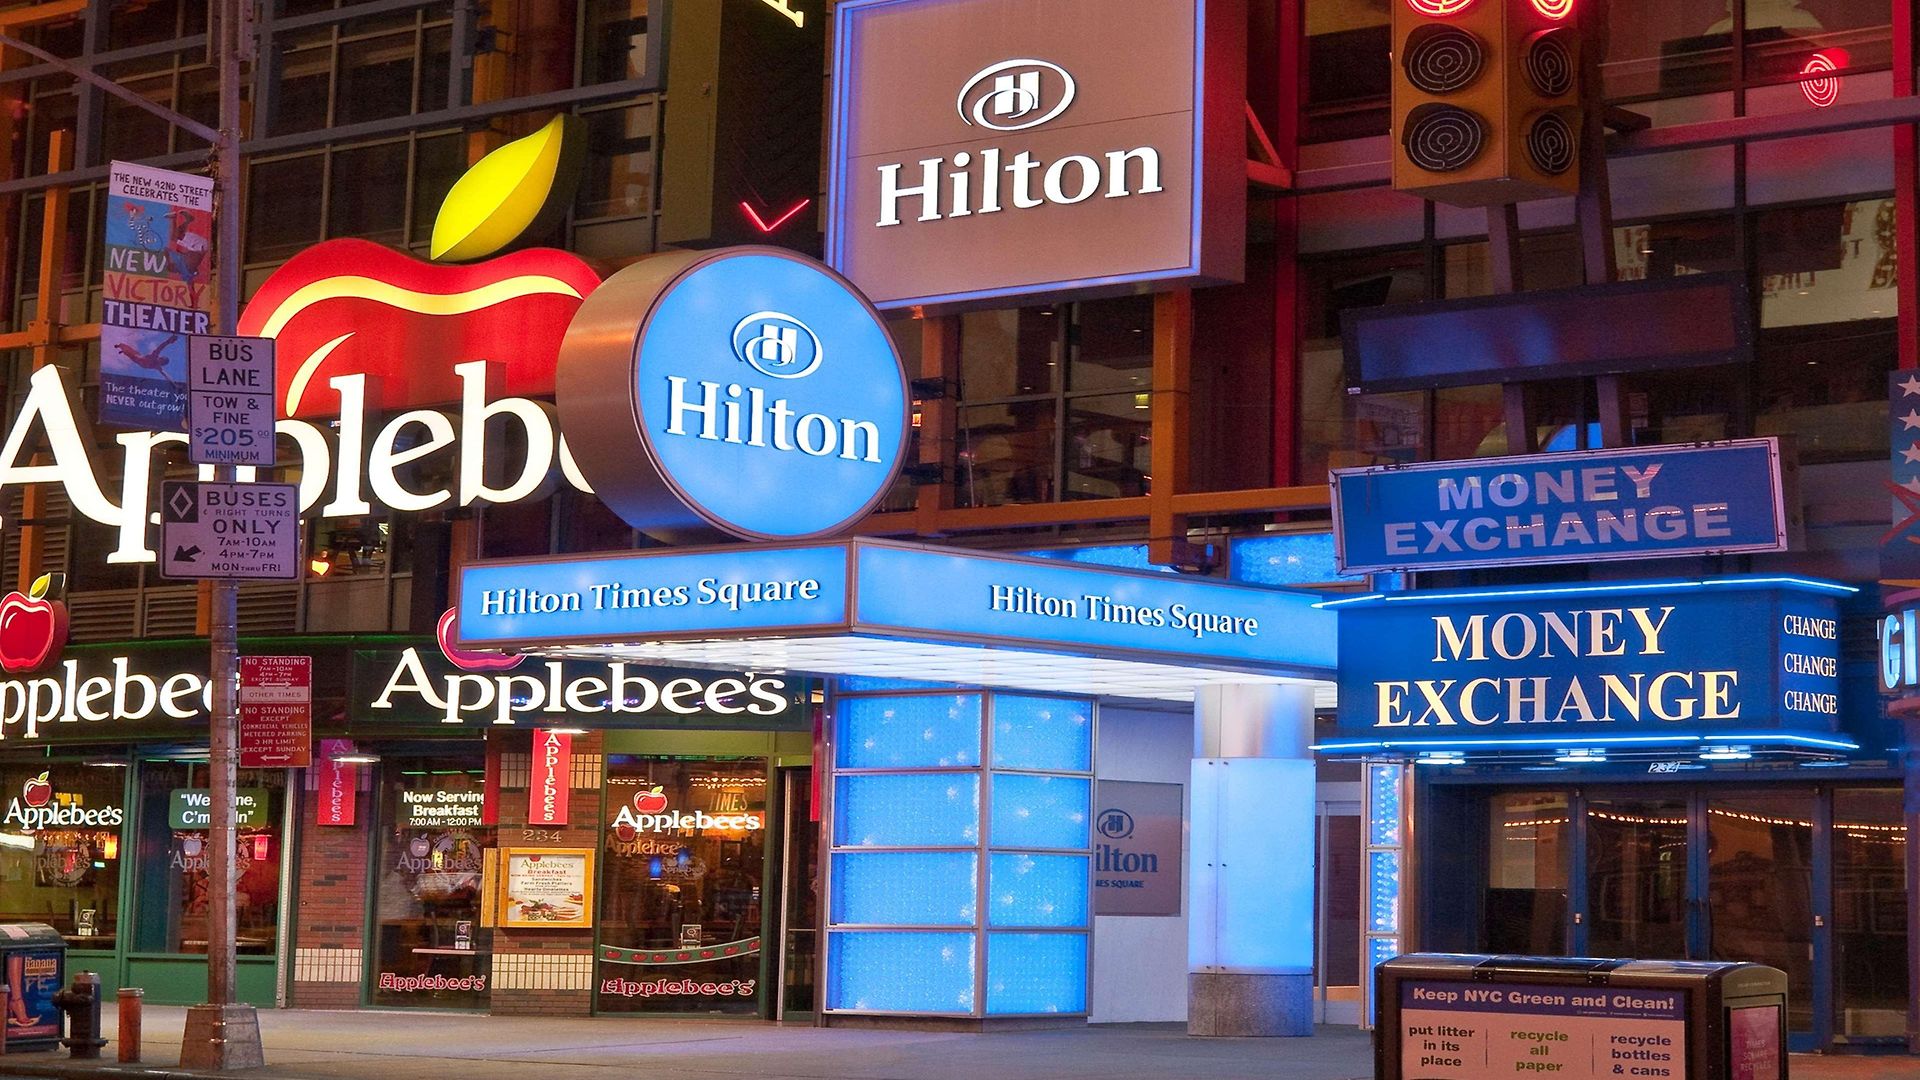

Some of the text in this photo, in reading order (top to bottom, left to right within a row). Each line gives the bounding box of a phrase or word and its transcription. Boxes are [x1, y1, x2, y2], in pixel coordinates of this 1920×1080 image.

[114, 173, 210, 197] THE NEW 42ND STREET
[875, 144, 1163, 228] Hilton
[123, 185, 199, 206] CELEBRATES THE
[110, 247, 166, 273] NEW
[109, 272, 206, 309] VICTORY
[105, 300, 208, 335] THEATER
[209, 343, 253, 362] BUS
[203, 367, 260, 387] LANE
[105, 382, 125, 392] The
[129, 383, 170, 398] theater
[106, 394, 185, 415] NEVER outgrow!
[203, 396, 259, 410] TOW &
[213, 412, 250, 425] FINE
[666, 375, 882, 464] Hilton
[205, 449, 259, 461] MINIMUM
[1438, 463, 1664, 512] MONEY
[206, 491, 286, 507] BUSES
[215, 509, 247, 517] RIGHT
[213, 519, 281, 534] ONLY
[1383, 502, 1732, 557] EXCHANGE
[481, 578, 820, 617] Hilton Times Square
[990, 584, 1259, 638] Hilton Times Square
[1431, 606, 1676, 663] MONEY
[1783, 614, 1837, 640] CHANGE
[1784, 653, 1837, 678] CHANGE
[370, 646, 788, 724] Applebee's
[1373, 670, 1740, 728] EXCHANGE
[1784, 690, 1838, 714] CHANGE
[1650, 762, 1679, 773] 234
[403, 791, 432, 803] Now
[3, 796, 123, 829] Applebee's
[412, 804, 479, 817] Breakfast
[611, 805, 761, 833] Applebee's
[409, 817, 426, 826] 7:00
[426, 817, 441, 826] AM
[447, 817, 467, 826] 12:00
[468, 817, 482, 826] PM
[522, 829, 562, 842] 234
[1111, 880, 1144, 888] SQUARE
[379, 972, 486, 991] Applebee's
[600, 978, 755, 998] Applebee's
[1413, 987, 1674, 1010] Keep NYC Green and Clean!
[1409, 1026, 1475, 1039] put litter
[1510, 1029, 1569, 1044] recycle
[1610, 1033, 1671, 1048] recycle
[1423, 1040, 1460, 1051] in its
[1530, 1045, 1549, 1056] all
[1420, 1054, 1462, 1068] place
[1611, 1049, 1671, 1062] bottles
[1516, 1061, 1563, 1073] paper
[1612, 1064, 1670, 1077] & cans
